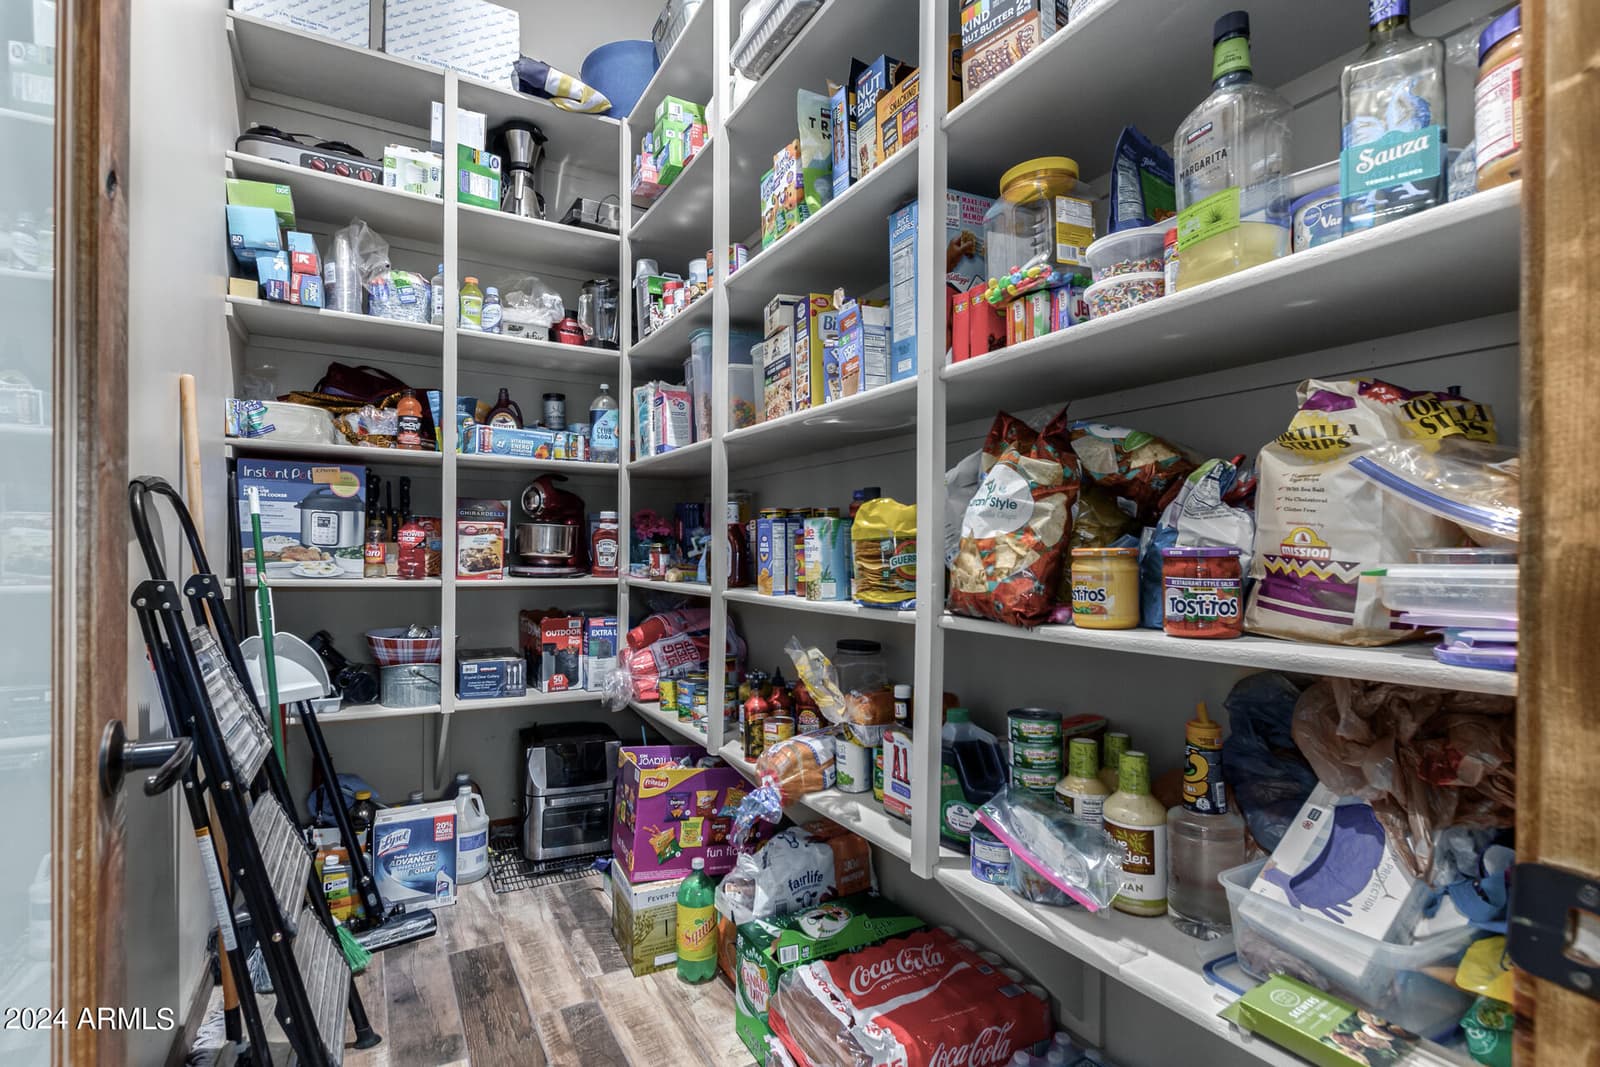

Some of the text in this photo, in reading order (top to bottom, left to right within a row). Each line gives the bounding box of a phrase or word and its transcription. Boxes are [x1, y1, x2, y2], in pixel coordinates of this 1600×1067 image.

[962, 10, 990, 36] KIND
[962, 7, 1014, 47] NUT BUTTER
[857, 71, 882, 104] NUT
[1356, 134, 1431, 174] Sauza
[1179, 148, 1228, 182] MARGARITA
[823, 315, 838, 331] Bi
[1280, 436, 1352, 451] STRIPS
[243, 465, 312, 480] Instant Pot
[989, 496, 1018, 510] Style
[459, 510, 505, 518] GHIRARDELLI
[1281, 546, 1330, 558] mission
[545, 628, 581, 638] OUTDOOR
[591, 629, 613, 637] EXTRA
[552, 675, 564, 684] 50
[706, 847, 723, 858] fun
[390, 854, 438, 868] ADVANCED
[788, 870, 824, 891] fairlife
[850, 943, 945, 996] Coca-Cola
[742, 966, 771, 994] CANADA
[880, 974, 918, 991] ORIGINAL
[929, 1018, 1017, 1067] Coca-Cola
